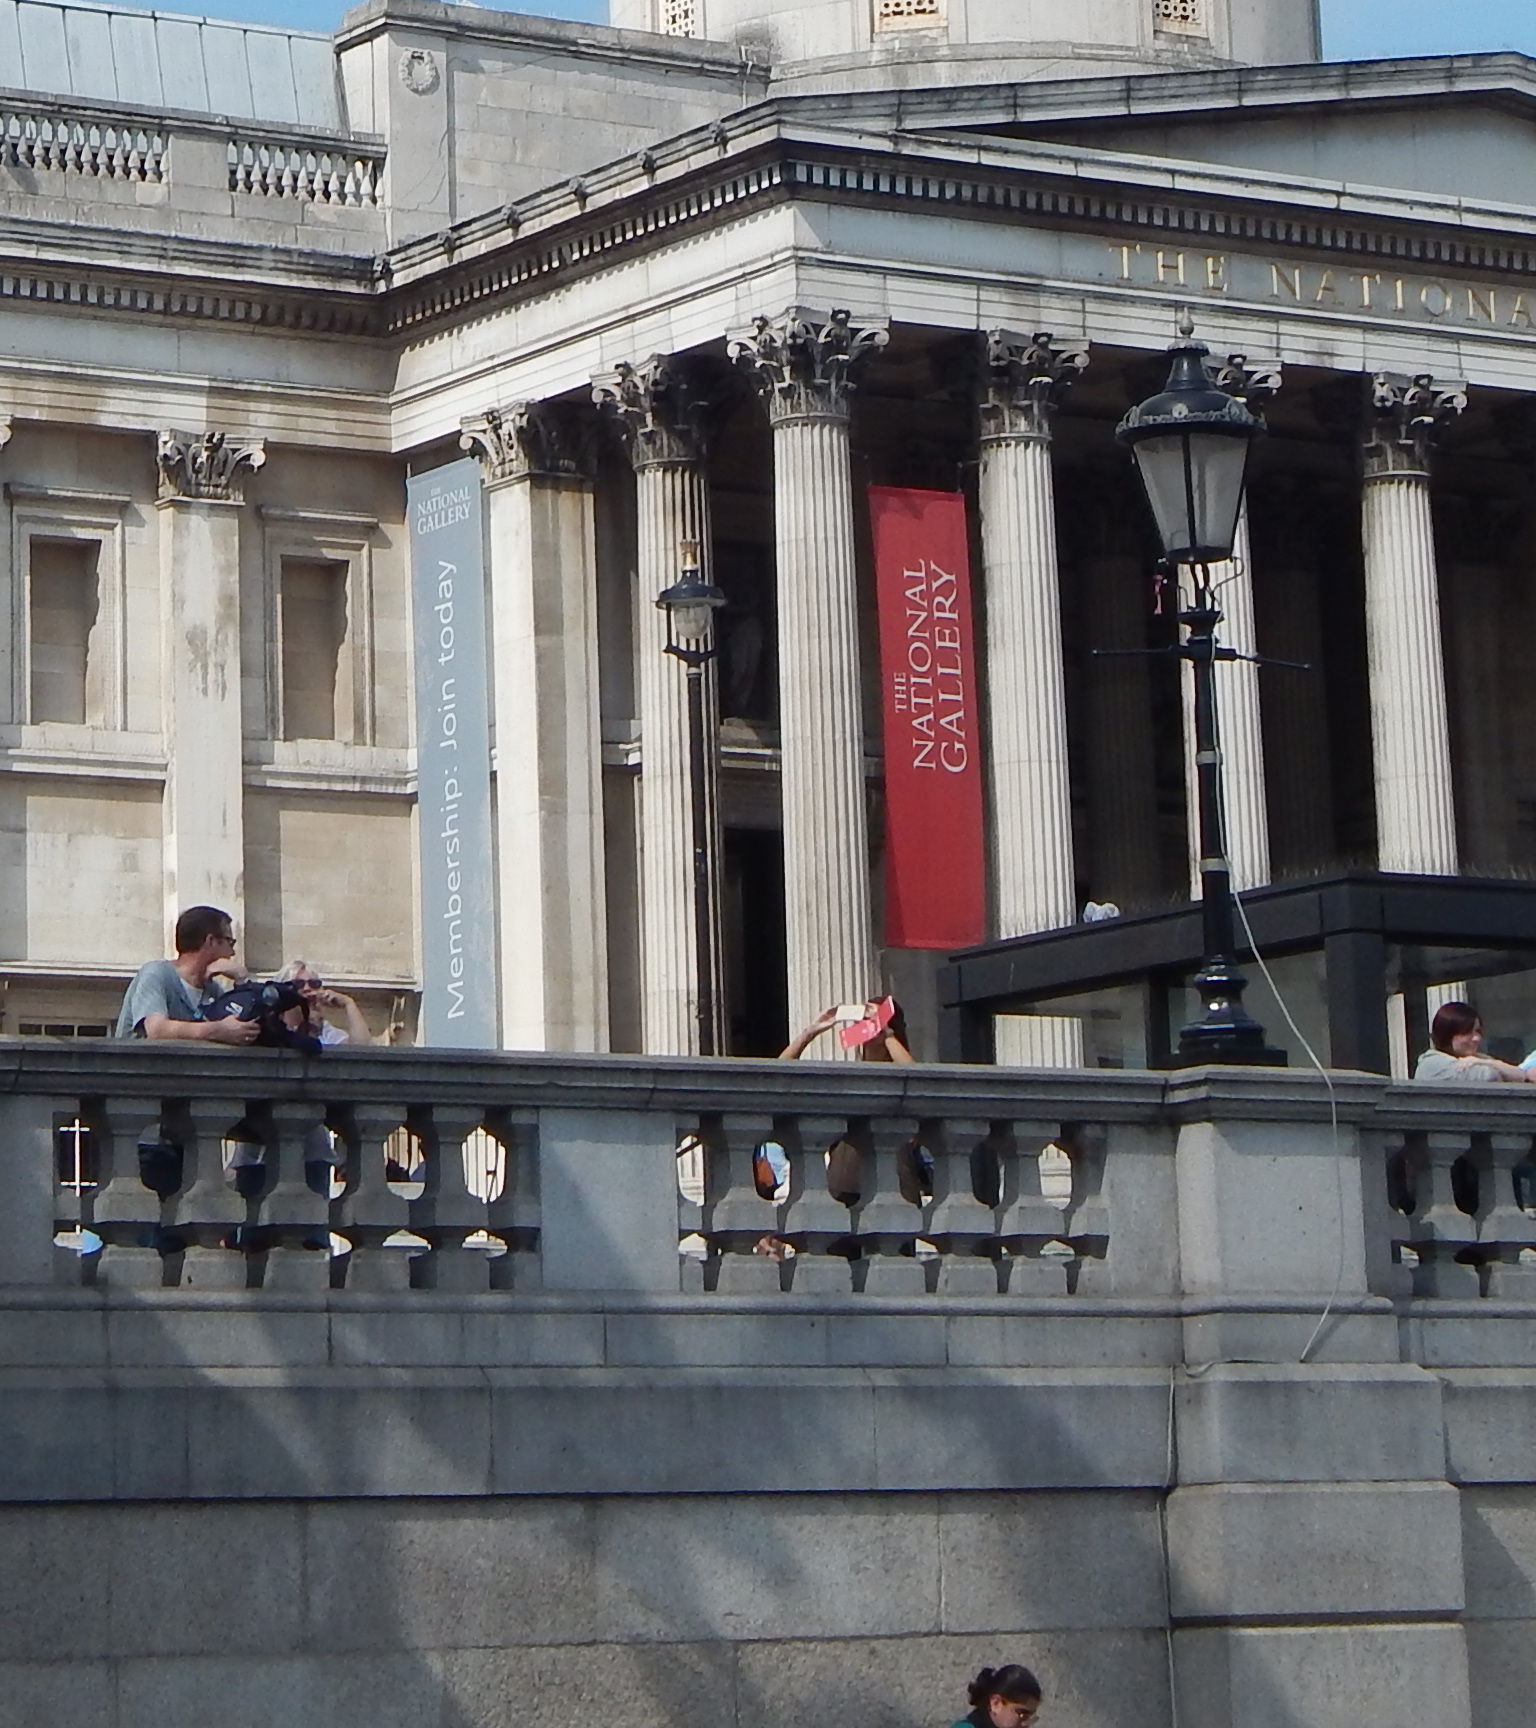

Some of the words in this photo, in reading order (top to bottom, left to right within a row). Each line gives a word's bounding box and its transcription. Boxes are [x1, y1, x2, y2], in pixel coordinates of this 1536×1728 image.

[1108, 243, 1229, 292] THE
[417, 486, 471, 517] NATIONAL
[417, 501, 471, 535] GALLERY
[434, 560, 457, 666] today
[894, 672, 907, 713] THE
[904, 558, 936, 770] NATIONAL
[930, 560, 968, 773] GALLERY
[437, 678, 458, 750] Join
[440, 766, 465, 1020] Membership:
